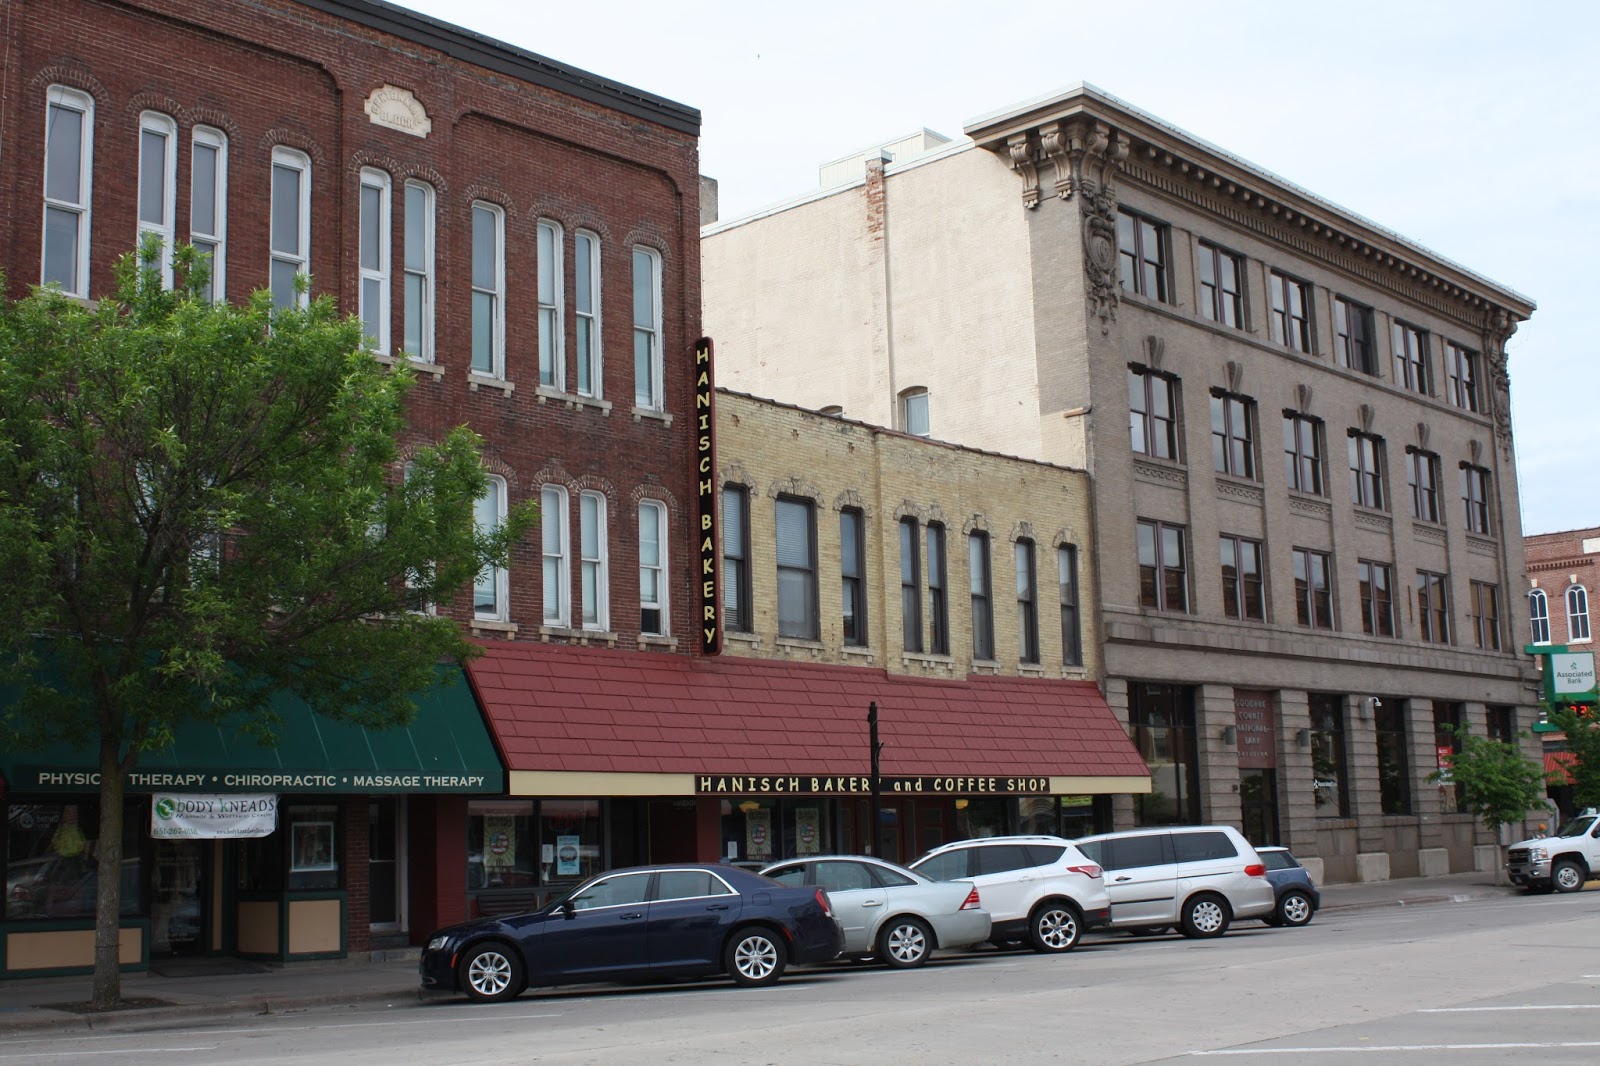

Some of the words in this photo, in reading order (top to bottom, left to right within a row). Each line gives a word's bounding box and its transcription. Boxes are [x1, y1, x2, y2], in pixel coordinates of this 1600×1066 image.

[380, 112, 414, 129] BLOCK
[696, 346, 712, 496] HANISCH
[701, 514, 716, 644] BAKERY
[1235, 699, 1266, 709] GOODHUE
[1239, 711, 1264, 721] COUNTY
[1236, 724, 1268, 733] NATIONAL
[1244, 736, 1261, 745] BANK
[38, 773, 102, 786] PHYSIC
[128, 773, 206, 786] THERAPY
[224, 774, 337, 788] CHIROPRACTIC
[353, 775, 421, 788] MASSAGE
[423, 775, 485, 789] THERAPY
[701, 776, 799, 792] HANISCH
[811, 776, 882, 792] BAKER
[893, 777, 923, 792] and
[934, 777, 996, 792] COFFEE
[1007, 778, 1047, 792] SHOP
